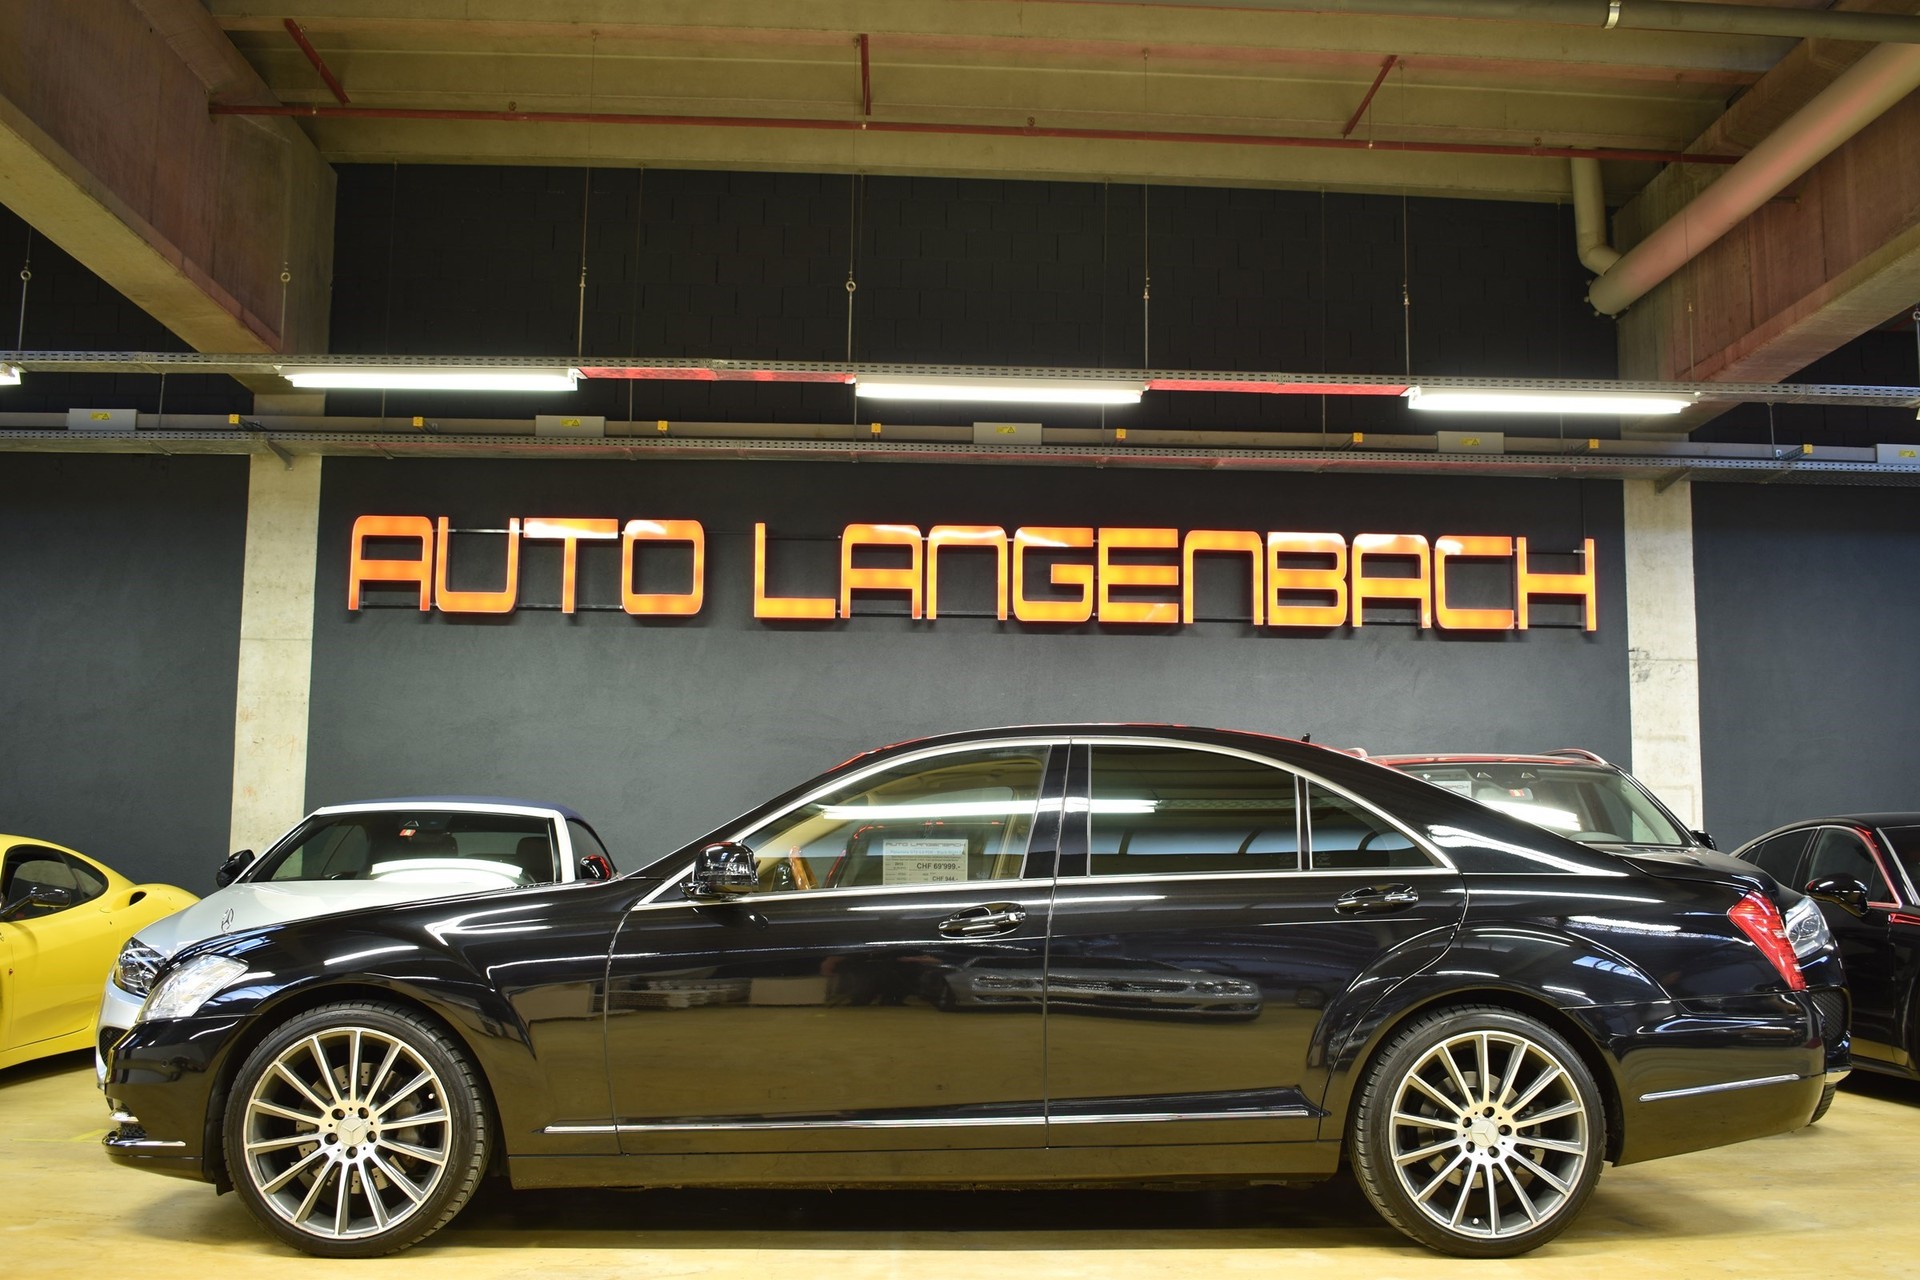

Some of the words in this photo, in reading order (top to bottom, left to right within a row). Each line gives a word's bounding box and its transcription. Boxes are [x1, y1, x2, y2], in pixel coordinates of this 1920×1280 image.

[347, 514, 706, 617] AUTO
[753, 521, 1598, 633] LANGENBACH
[916, 862, 932, 870] CHF
